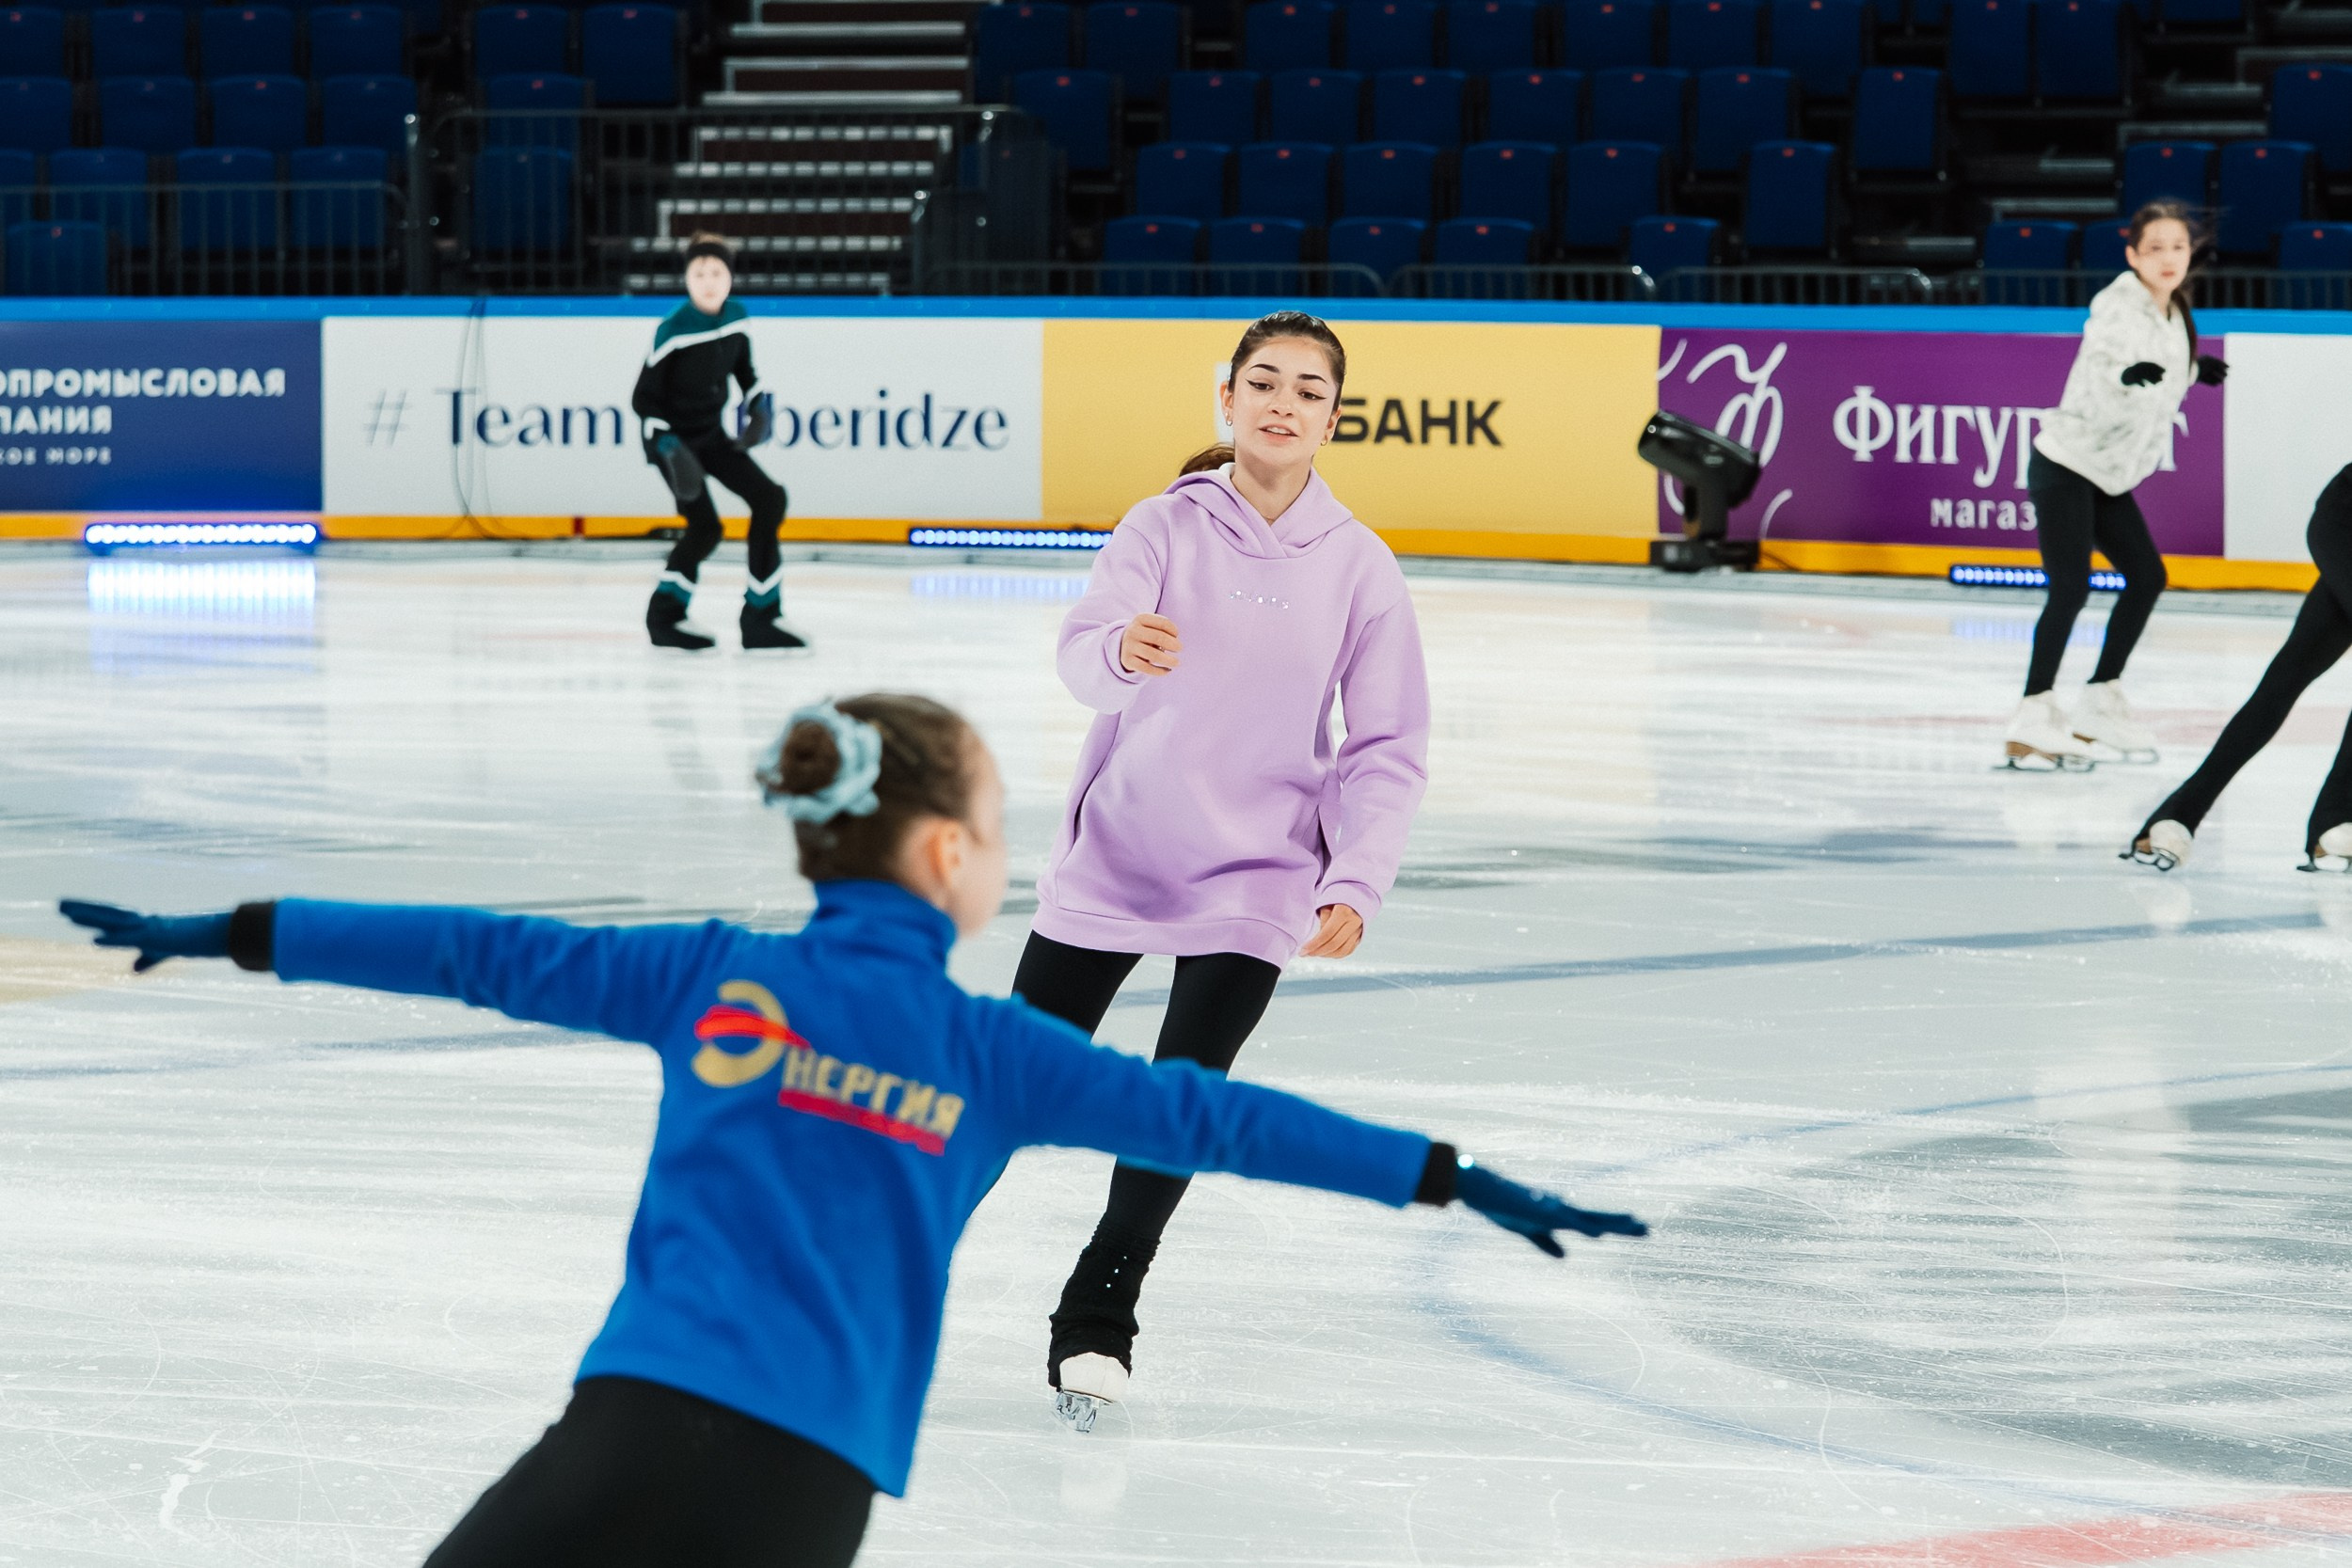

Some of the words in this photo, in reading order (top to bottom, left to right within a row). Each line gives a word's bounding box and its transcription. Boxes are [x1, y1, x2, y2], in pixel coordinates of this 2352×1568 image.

[0, 368, 286, 398] ПРОМЫСЛОВАЯ
[433, 385, 623, 448] Team
[737, 388, 1009, 450] beridze
[1331, 397, 1502, 445] БАНК
[1930, 498, 2038, 531] магаз
